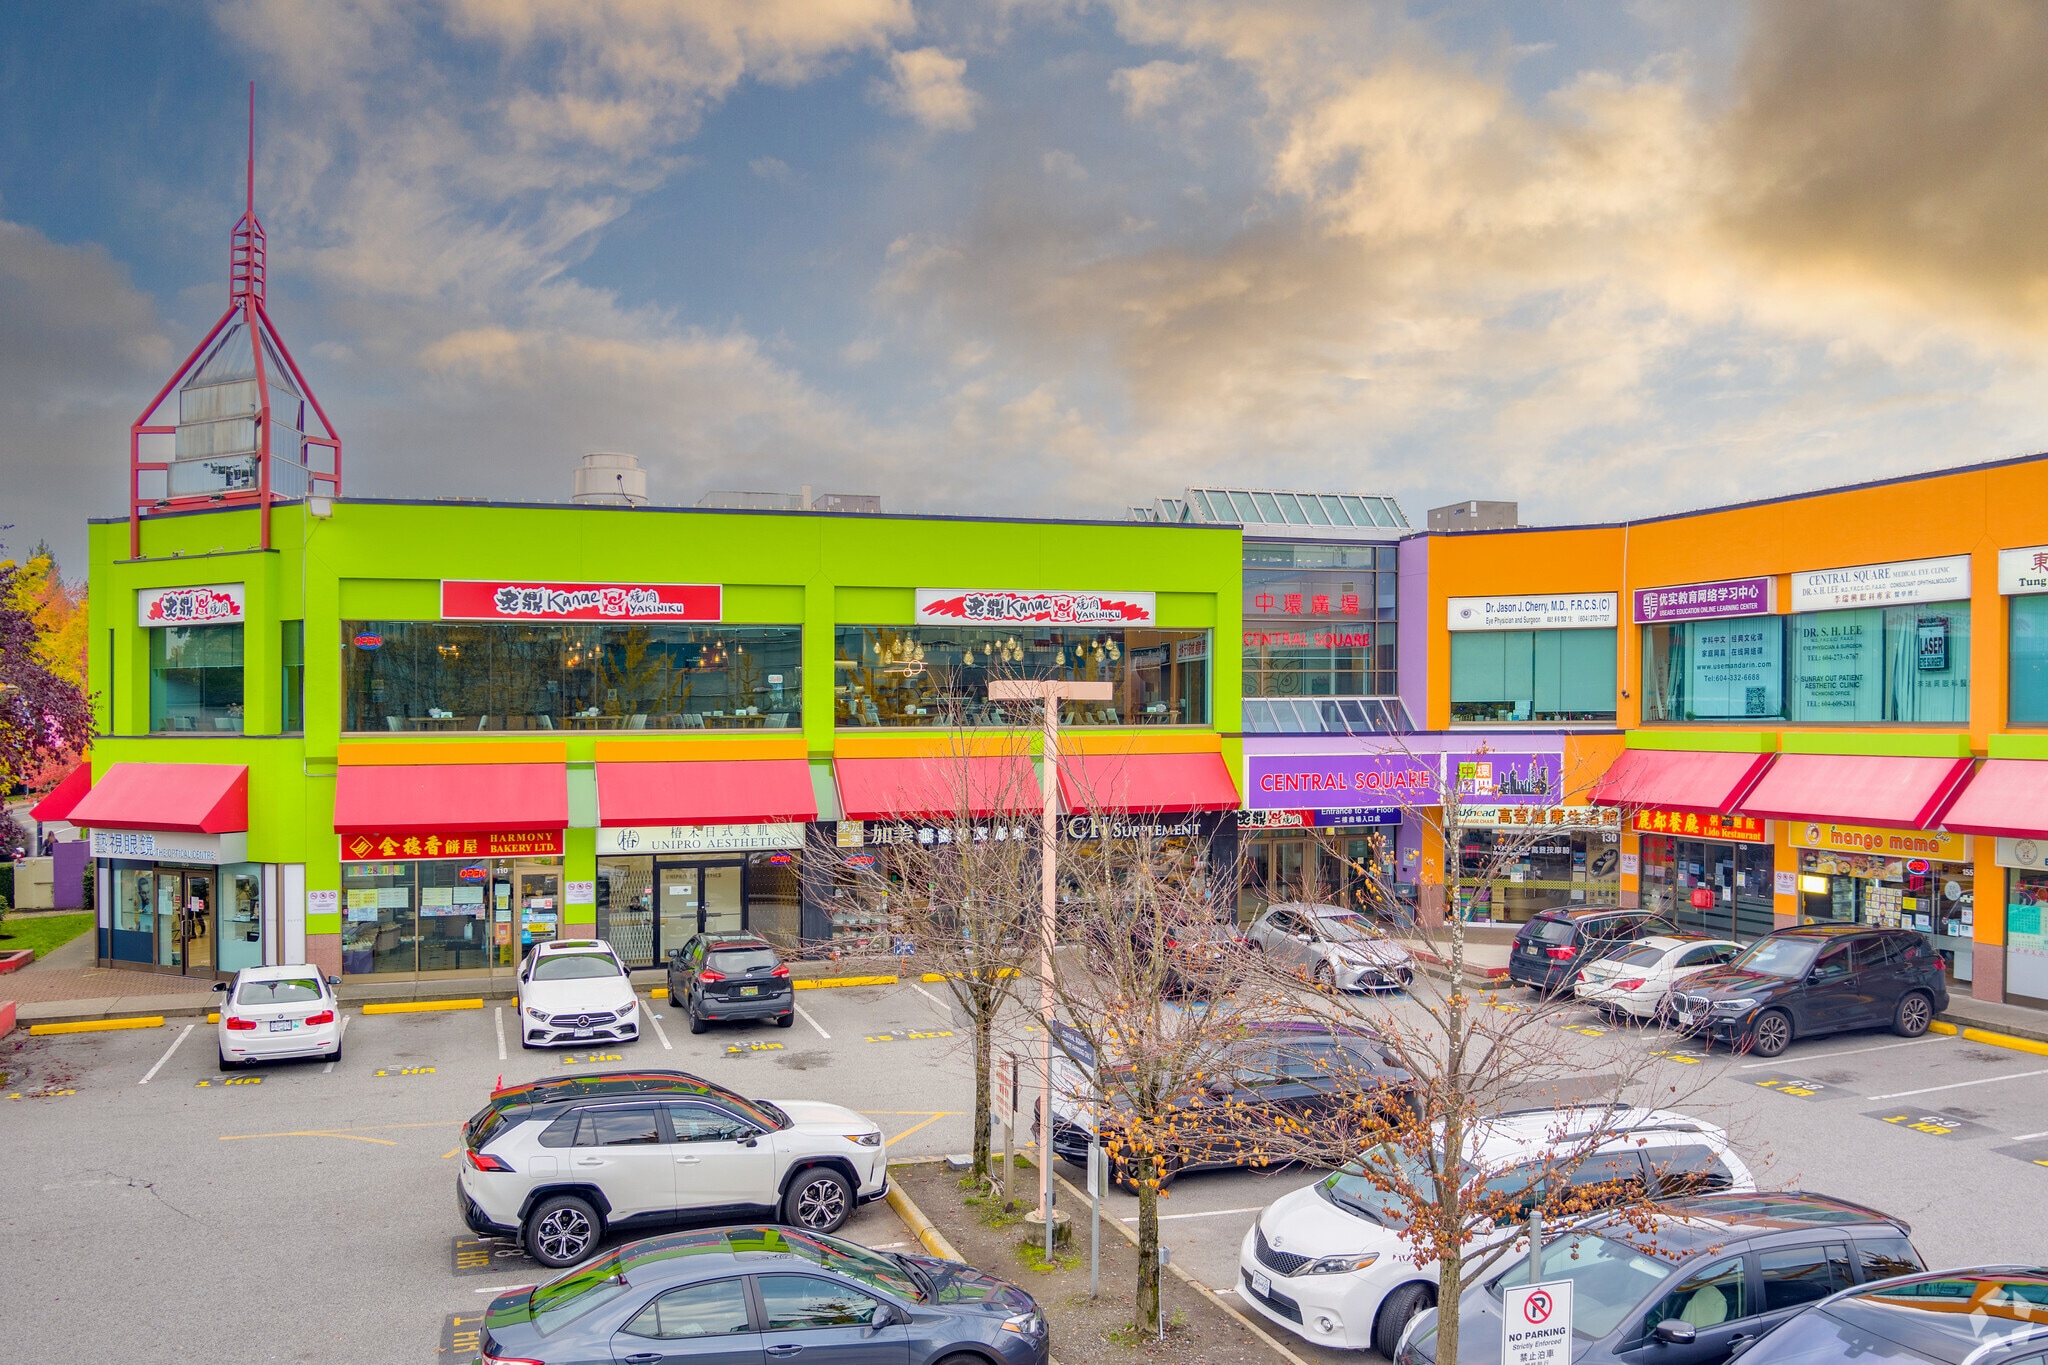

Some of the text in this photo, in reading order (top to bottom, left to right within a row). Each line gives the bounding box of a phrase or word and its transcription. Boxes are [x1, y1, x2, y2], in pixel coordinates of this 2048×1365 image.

[1809, 571, 1851, 586] CENTRAL
[1853, 568, 1891, 583] SQUARE
[1918, 568, 1929, 576] EYE
[2018, 577, 2047, 588] Tung
[1659, 585, 1759, 606] 优实教育网络学习中心
[1827, 585, 1839, 594] LEE
[547, 591, 600, 612] Kanae
[1006, 598, 1051, 617] Kanae
[1255, 592, 1360, 616] 中環廣場
[1485, 602, 1496, 613] Dr.
[1497, 602, 1516, 613] Jason
[1518, 601, 1524, 612] J.
[630, 603, 683, 615] YAKINIKU
[1076, 610, 1121, 620] YAKINIKU
[1677, 607, 1700, 615] EDUCATION
[1717, 604, 1739, 612] LEARNING
[1740, 602, 1758, 610] CENTER
[1485, 617, 1494, 626] Eye
[1494, 616, 1514, 625] Physician
[1515, 616, 1523, 624] and
[1523, 616, 1541, 625] Surgeon
[1803, 625, 1863, 638] DR. S. H. LEE
[354, 635, 381, 646] OPEN
[1243, 631, 1371, 649] CENTRAL SQUARE
[1920, 637, 1943, 655] LASER
[1696, 661, 1772, 670] www.usemandarin.com
[1260, 770, 1430, 792] CENTRAL SQUARE
[1321, 807, 1353, 815] Entrance
[1376, 806, 1395, 814] Floor
[490, 833, 553, 843] HARMONY
[1601, 833, 1617, 843] 130
[1704, 826, 1761, 841] Lido Restaurant
[94, 832, 155, 856] 藝視眼鏡
[490, 842, 557, 853] BAKERY LTD.
[652, 837, 788, 850] UNIPRO AESTHETICS
[1830, 829, 1940, 853] mango mama
[770, 855, 792, 863] OPEN
[459, 869, 487, 879] OPEN
[1962, 868, 1974, 876] 155
[1776, 1086, 1817, 1097] HR
[1907, 1122, 1953, 1135] HR
[457, 1250, 489, 1269] HR
[1508, 1326, 1566, 1342] NO PARKING
[1512, 1338, 1562, 1351] Strictly Enforced
[1520, 1349, 1554, 1362] 禁止泊車
